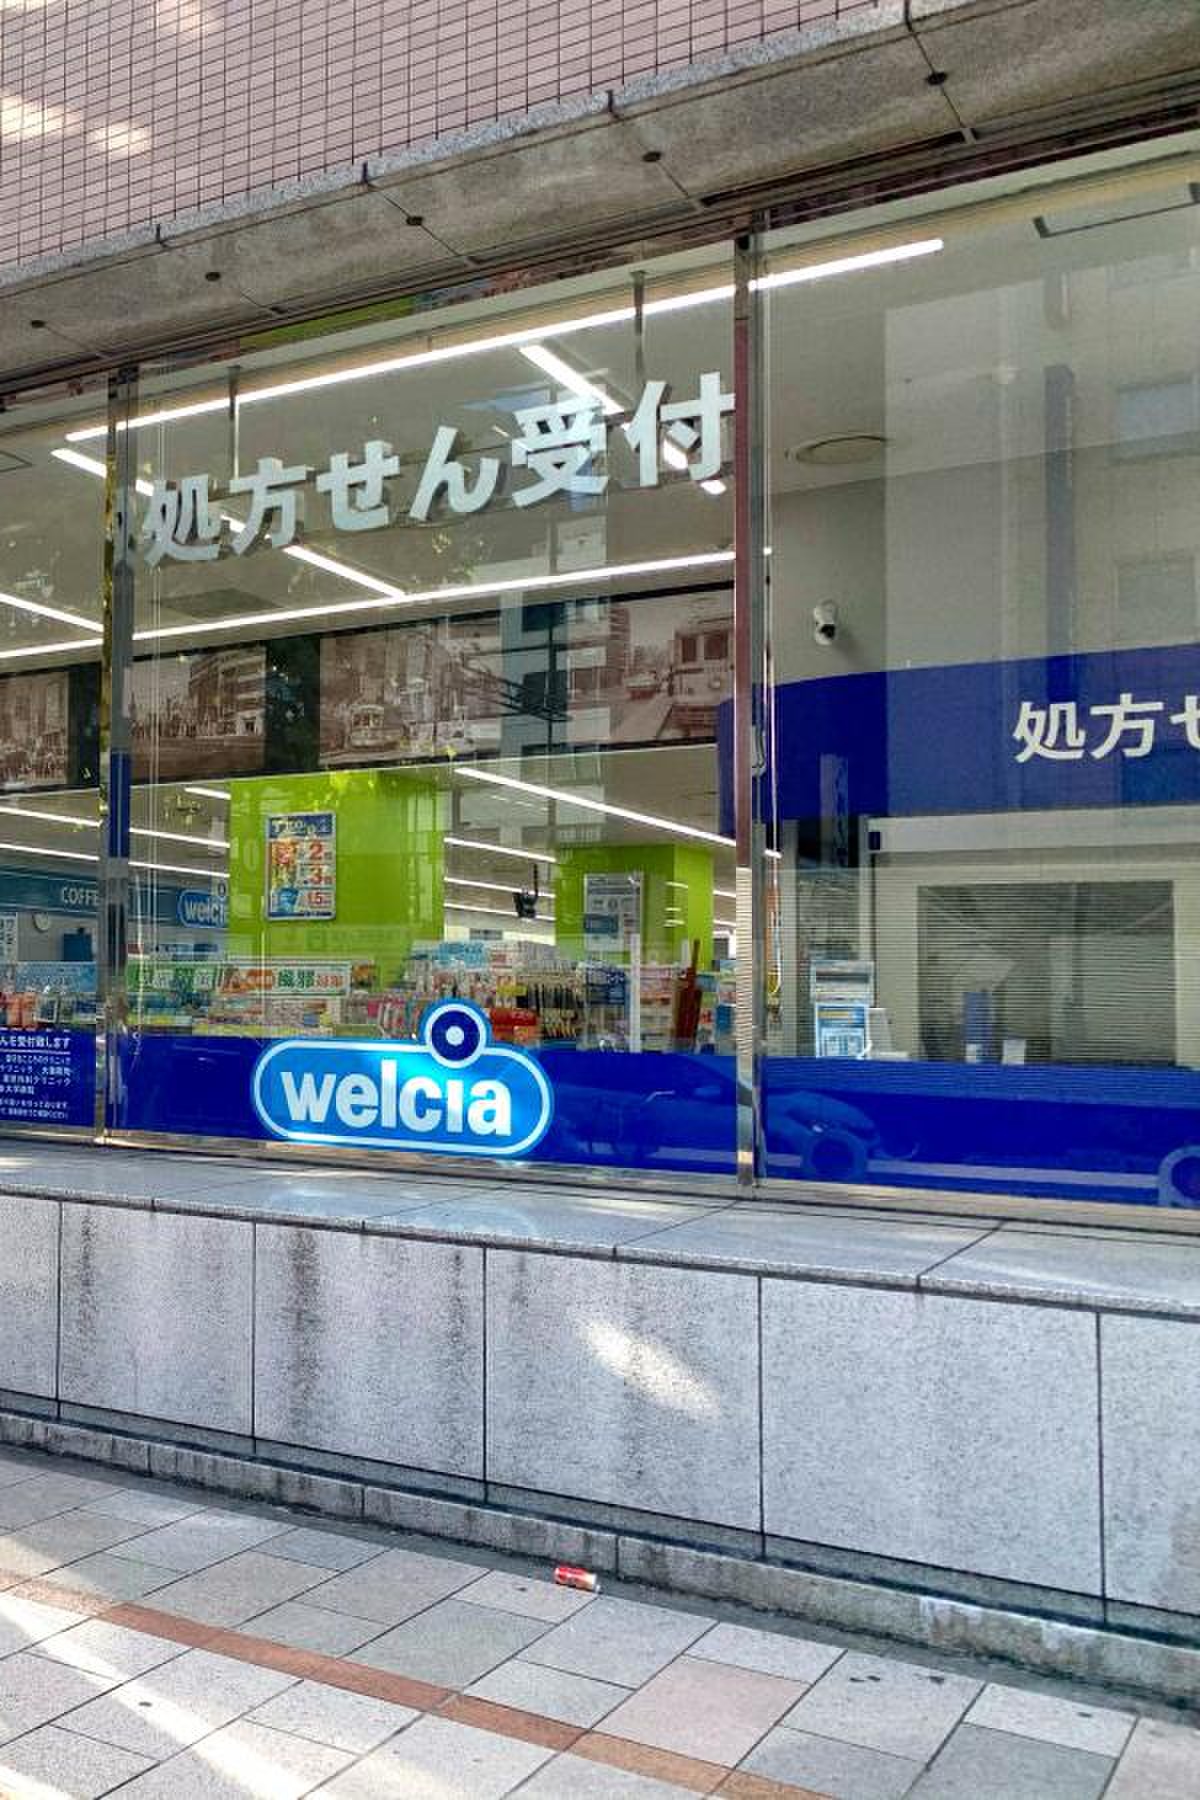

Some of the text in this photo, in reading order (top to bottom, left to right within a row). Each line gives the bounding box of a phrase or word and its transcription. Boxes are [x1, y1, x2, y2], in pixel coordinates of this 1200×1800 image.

[144, 372, 734, 567] 処方せん受付
[280, 1059, 512, 1137] welcia
